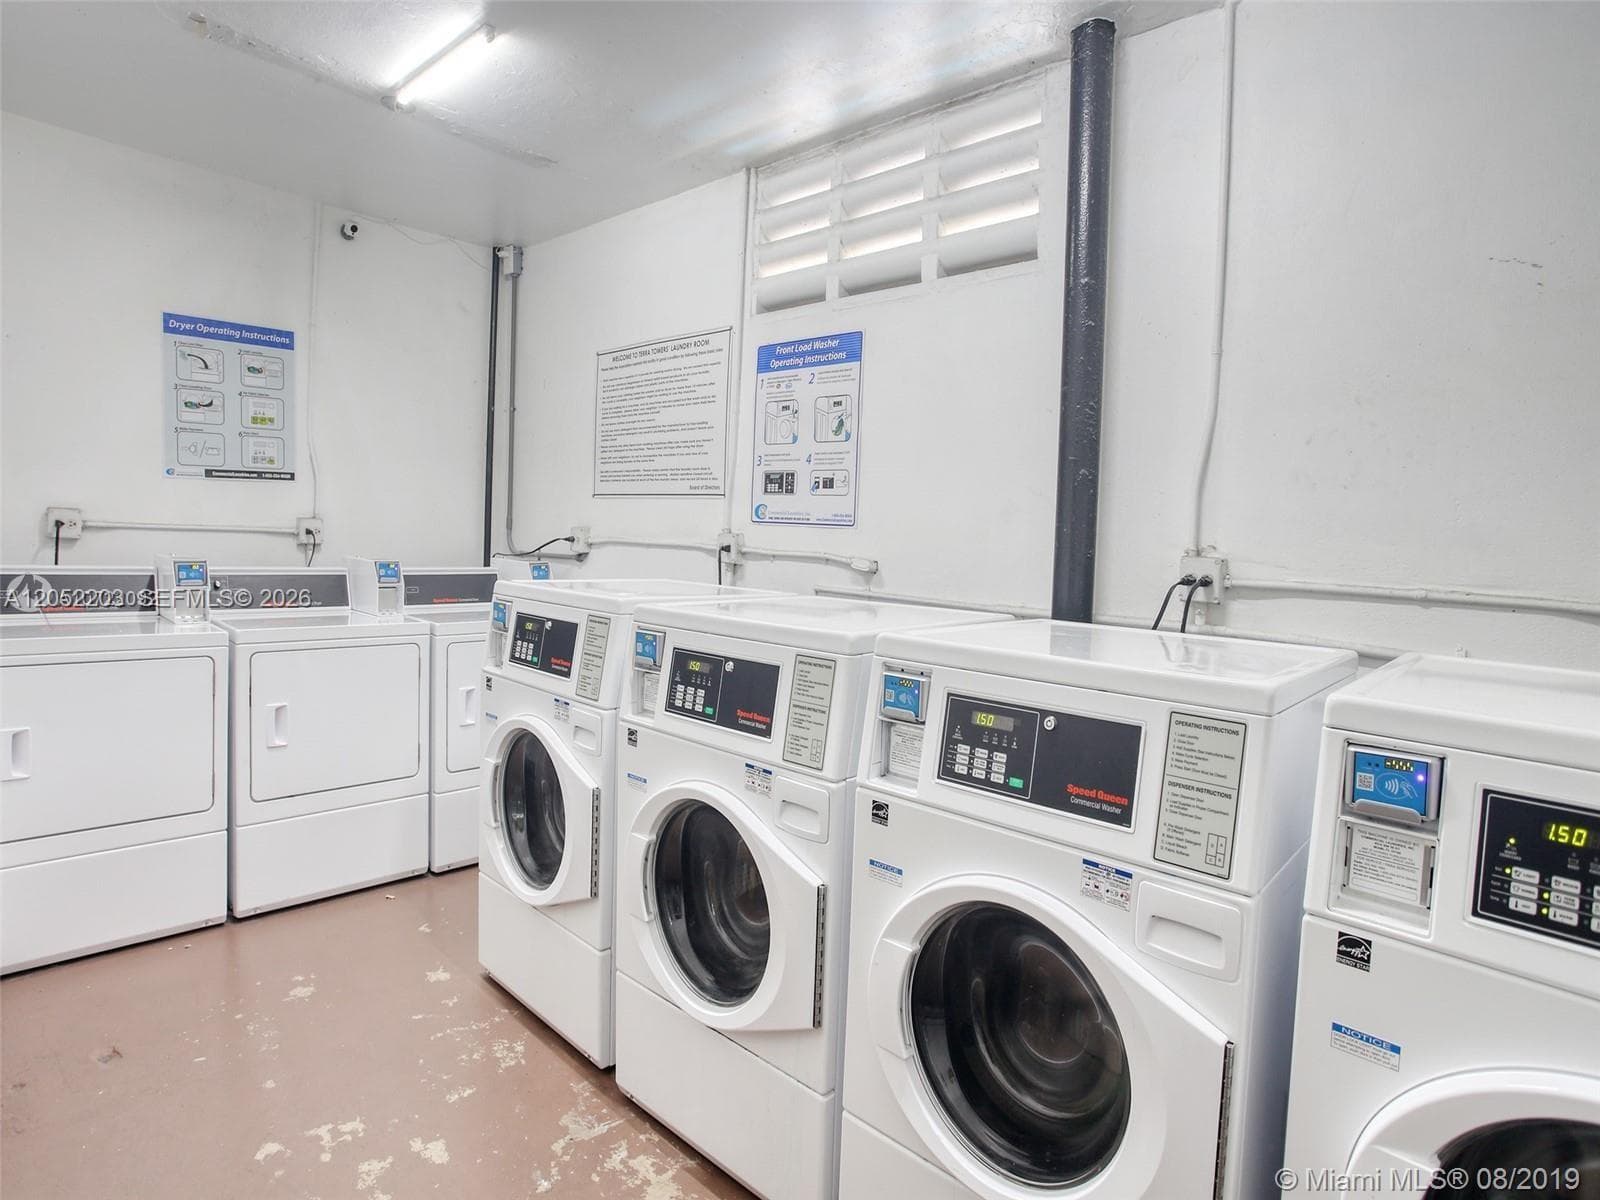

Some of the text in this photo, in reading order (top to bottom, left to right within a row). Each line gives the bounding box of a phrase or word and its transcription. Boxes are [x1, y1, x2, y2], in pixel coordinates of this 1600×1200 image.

[169, 319, 290, 344] Dryer Operating Instructions
[612, 352, 632, 362] WELCOME
[633, 351, 638, 359] TO
[639, 349, 651, 358] TERRA
[671, 342, 692, 352] LAUNDRY
[694, 339, 710, 347] ROOM
[776, 338, 840, 355] Front Load Washer
[770, 351, 846, 369] Operating Instructions
[760, 379, 764, 390] 1
[808, 372, 815, 384] 2
[757, 456, 762, 466] 3
[806, 454, 812, 464] 4
[737, 709, 769, 724] Speed Queen
[1174, 719, 1239, 736] OPERATING INSTRUCTIONS
[1067, 784, 1128, 805] Speed Queen
[1167, 780, 1232, 799] DISPENSER INSTRUCTIONS
[1070, 796, 1122, 814] Commercial Washer
[1549, 824, 1588, 847] 1.50
[1337, 957, 1370, 971] ENERGY STAR
[1342, 1027, 1391, 1051] NOTICE
